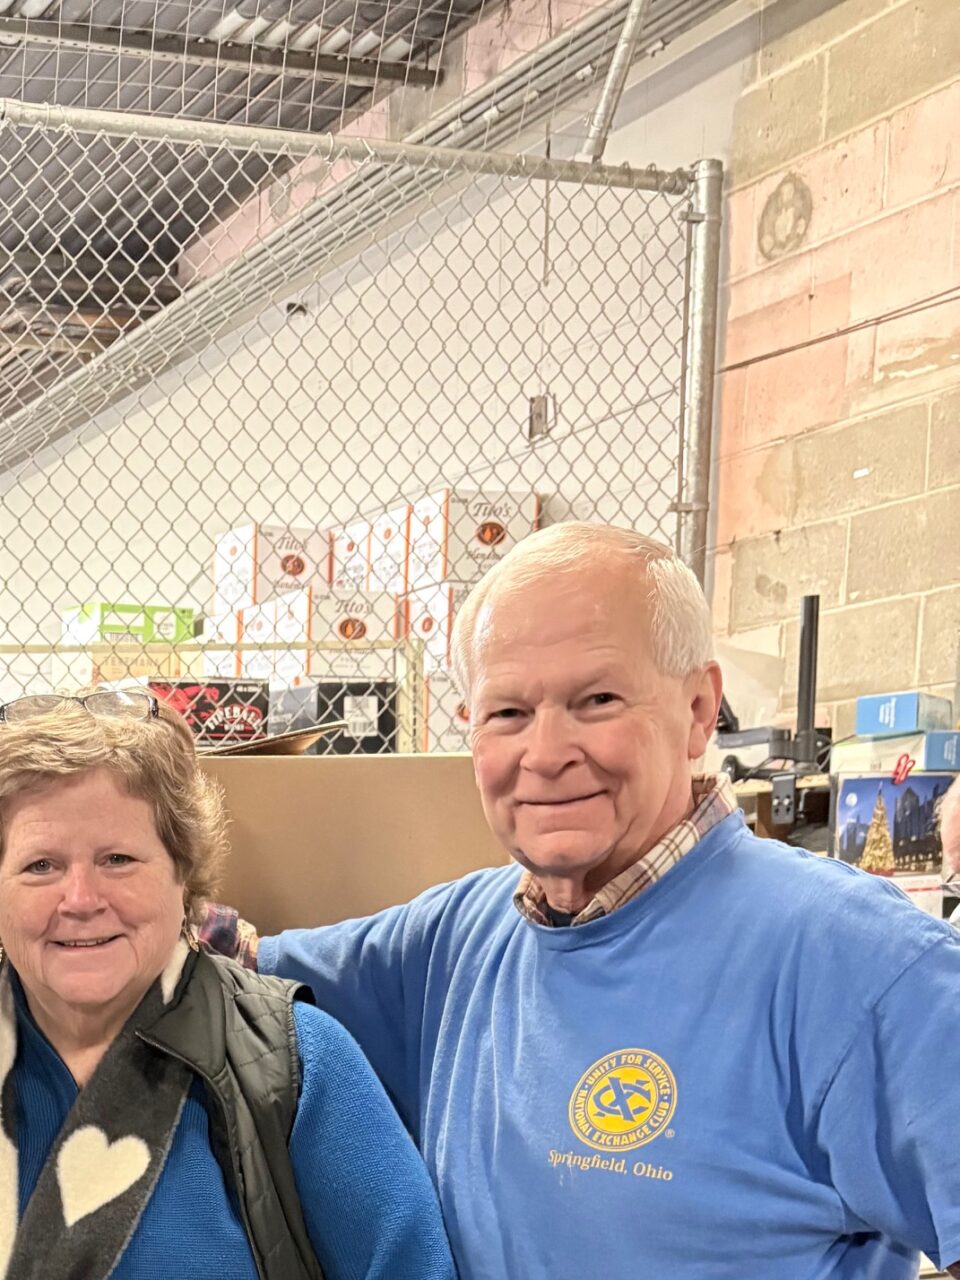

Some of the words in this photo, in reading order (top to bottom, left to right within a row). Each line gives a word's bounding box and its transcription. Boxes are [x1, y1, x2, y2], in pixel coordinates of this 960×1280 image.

[472, 501, 512, 518] Tito's
[586, 1057, 617, 1085] UNITY
[620, 1054, 643, 1065] FOR
[643, 1058, 671, 1095] SERVICE
[574, 1089, 593, 1137] NATIONAL
[591, 1124, 652, 1146] EXCHANGE
[648, 1101, 670, 1128] CLUB
[547, 1149, 628, 1175] Springfield,
[632, 1160, 673, 1181] Ohio
